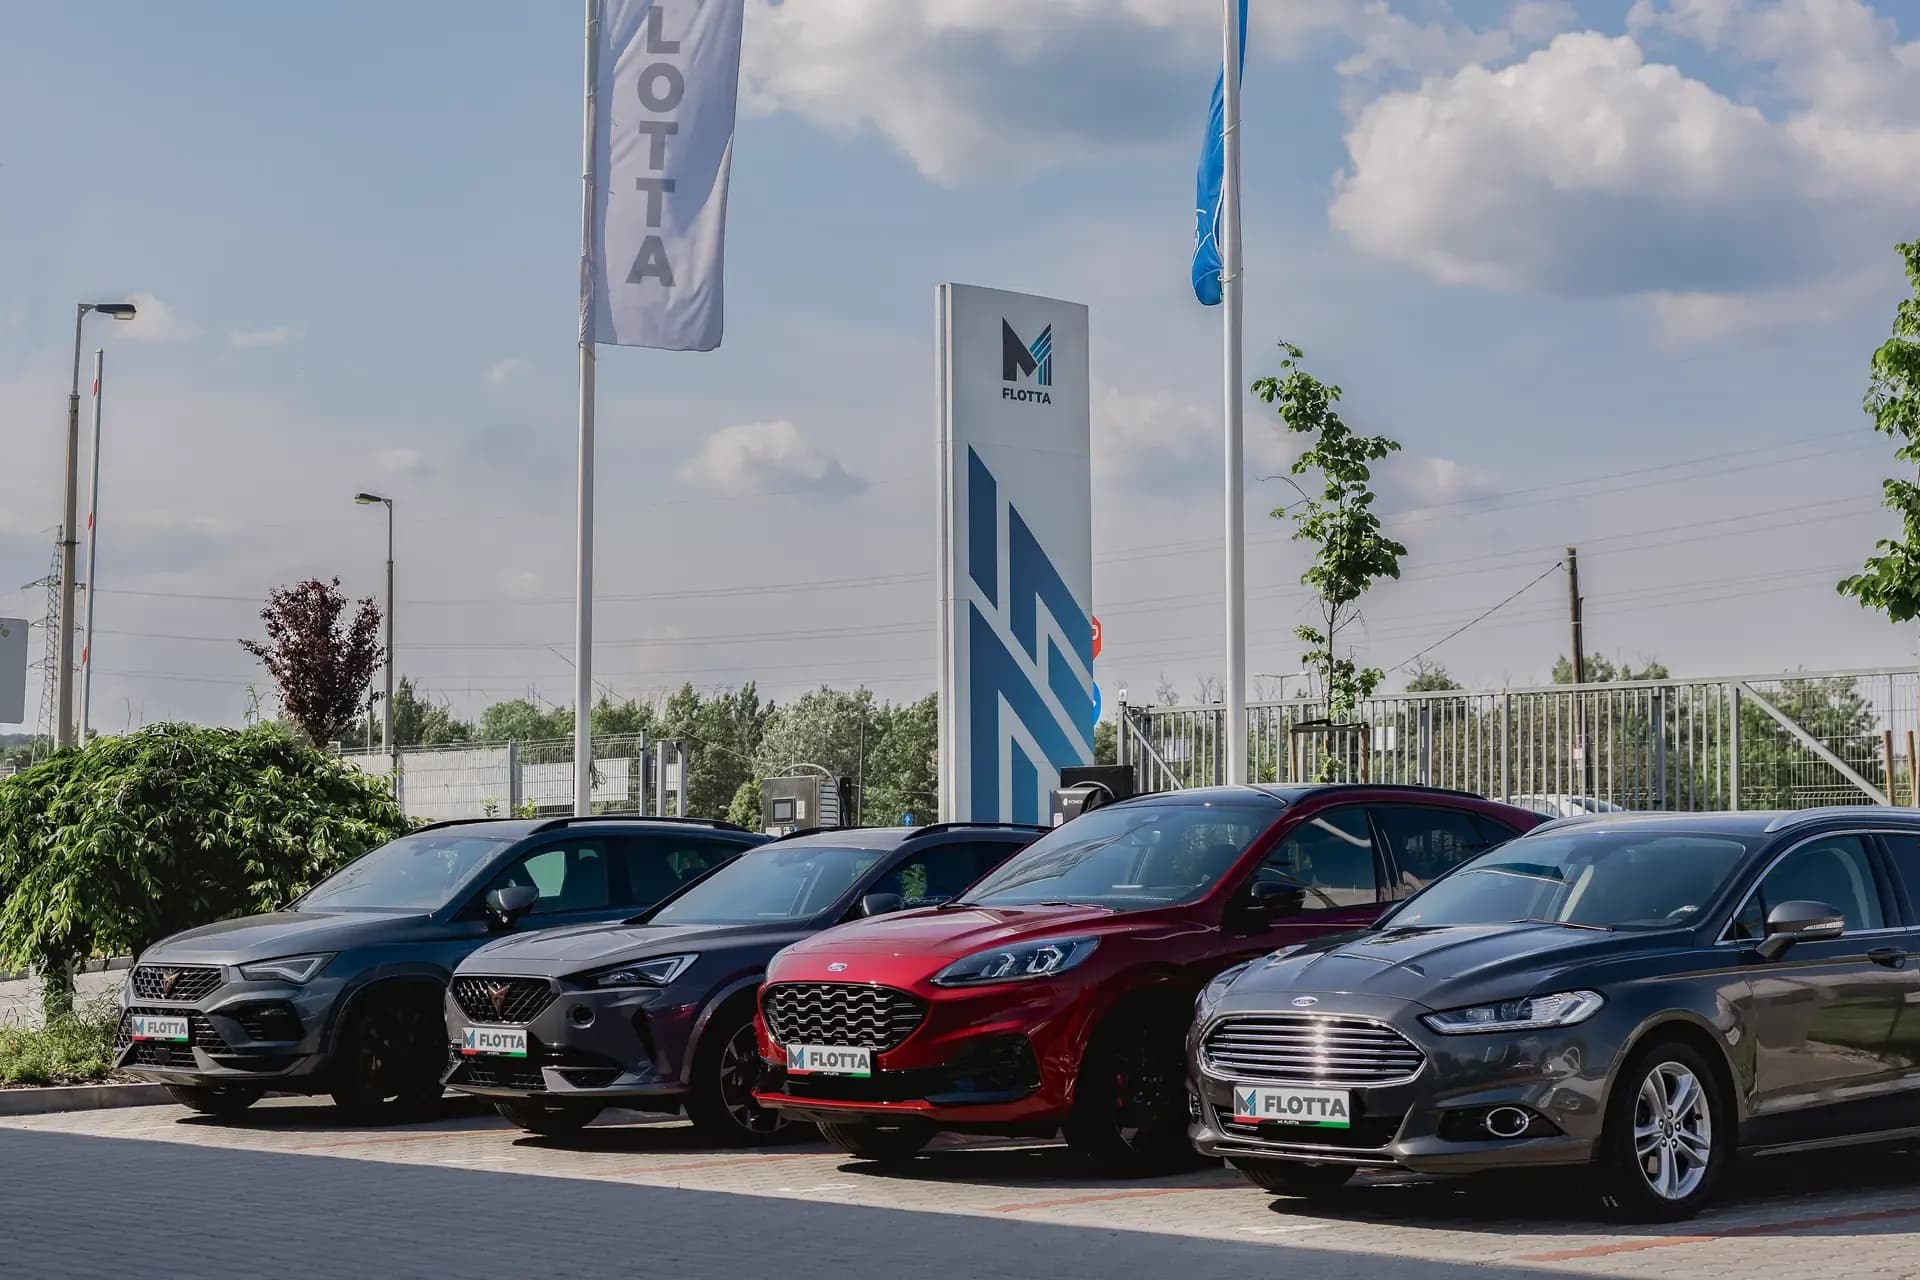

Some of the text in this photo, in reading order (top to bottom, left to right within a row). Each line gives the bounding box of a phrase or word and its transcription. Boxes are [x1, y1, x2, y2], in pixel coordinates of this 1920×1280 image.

[625, 6, 685, 287] LOTTA
[1002, 387, 1052, 404] FLOTTA
[148, 1022, 187, 1034] FLOTTA
[480, 1034, 525, 1048] FLOTTA
[810, 1052, 869, 1068] FLOTTA
[1265, 1095, 1347, 1117] FLOTTA
